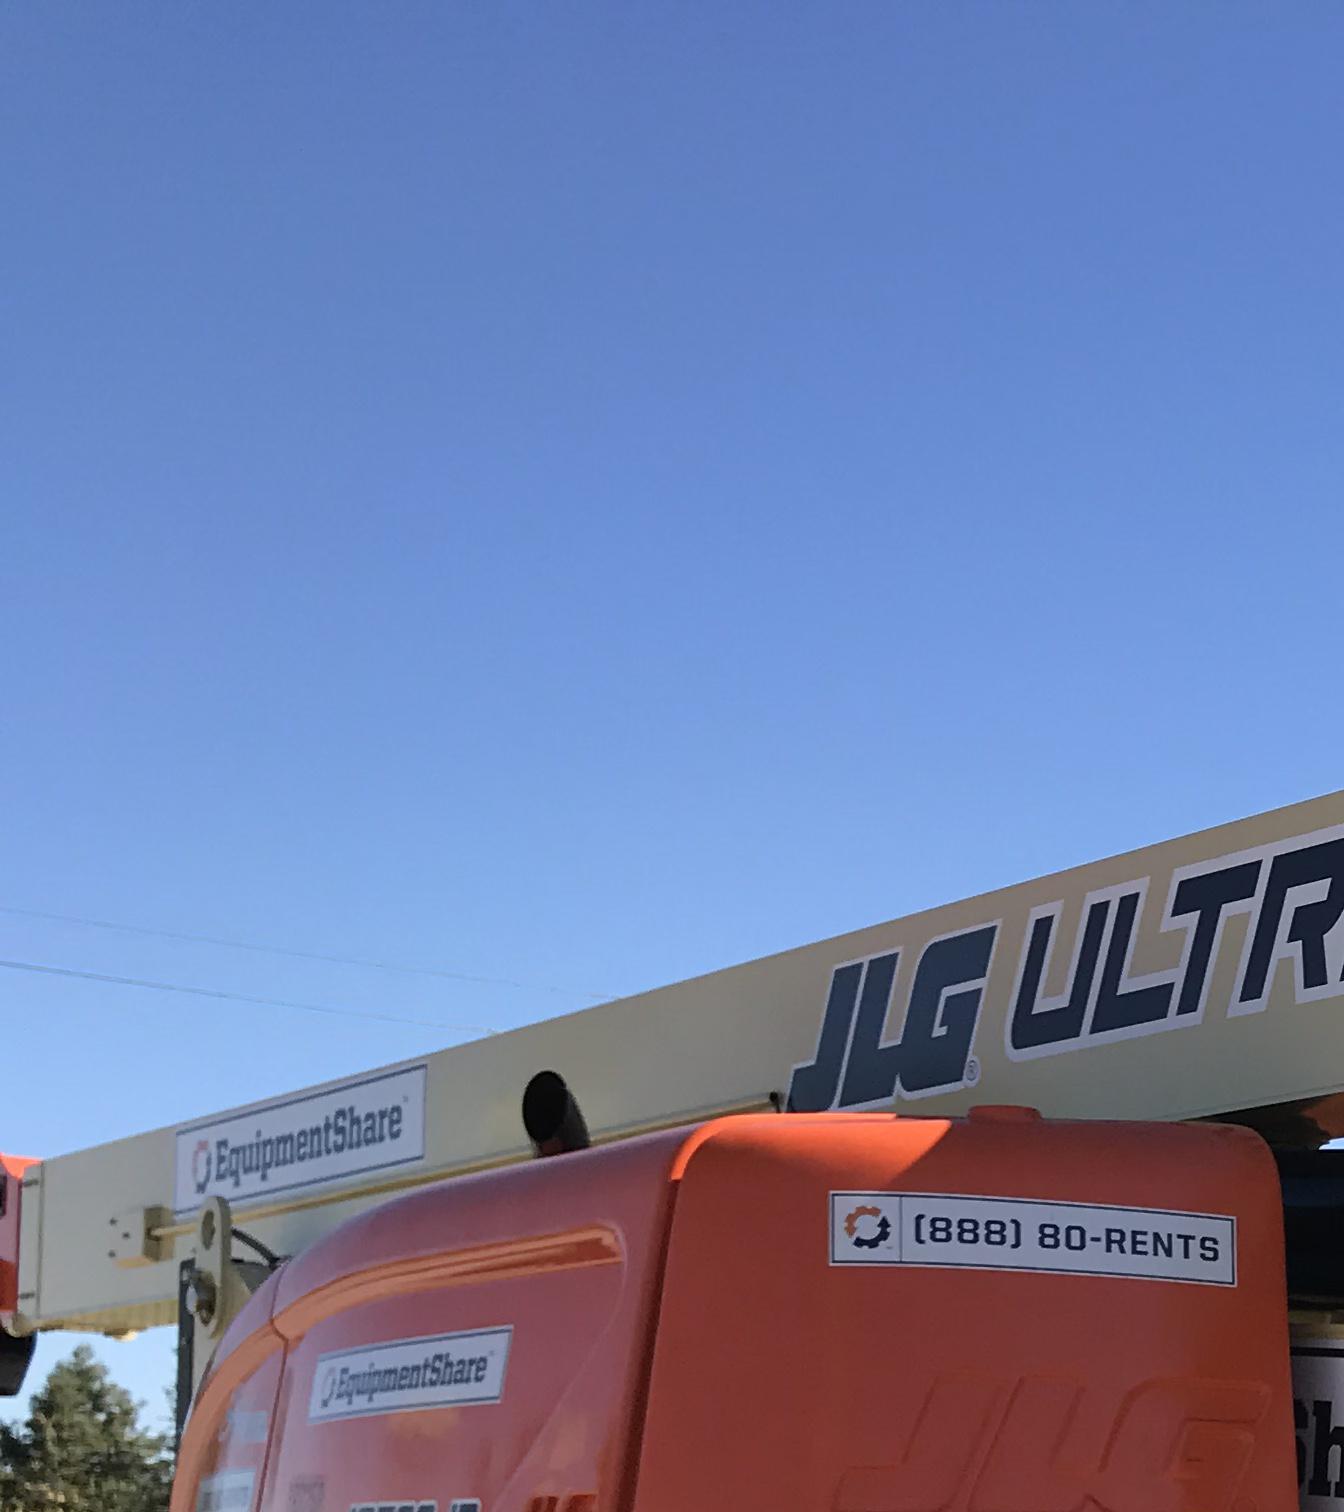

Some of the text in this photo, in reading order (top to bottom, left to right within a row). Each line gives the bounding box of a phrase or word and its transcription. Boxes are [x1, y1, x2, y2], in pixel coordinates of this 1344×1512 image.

[786, 924, 999, 1113] JLG
[215, 1104, 403, 1188] EquipmentShare
[914, 1214, 1220, 1262] (888) 80-RENTS
[336, 1353, 488, 1405] EquipmentShare
